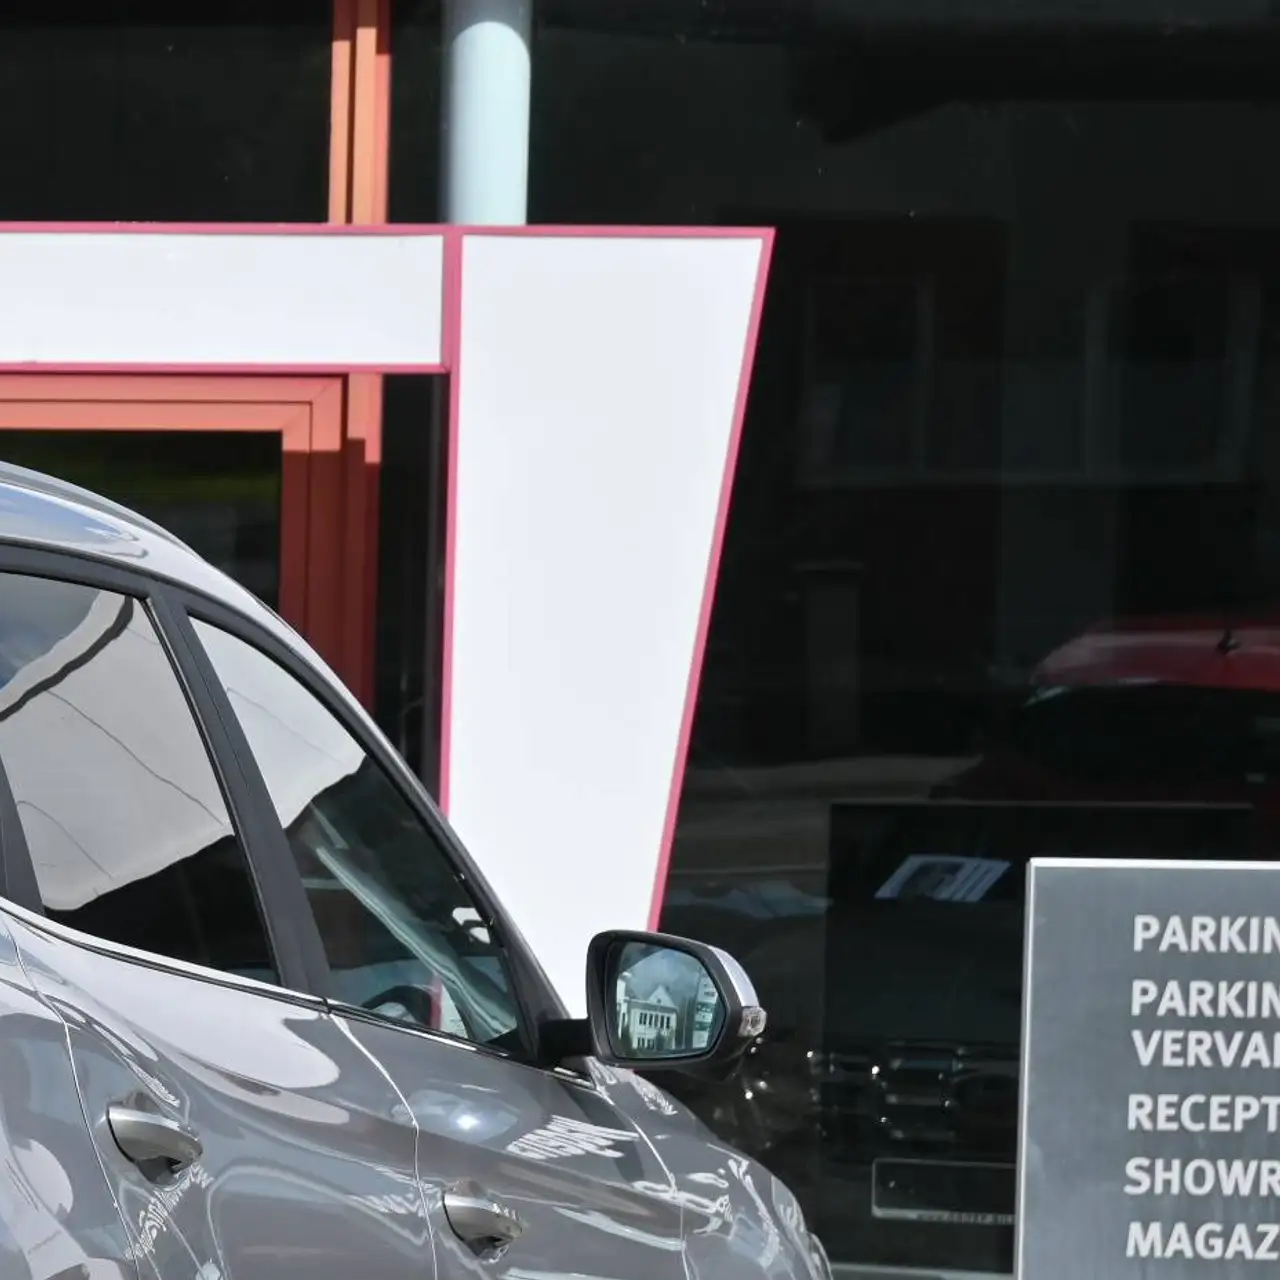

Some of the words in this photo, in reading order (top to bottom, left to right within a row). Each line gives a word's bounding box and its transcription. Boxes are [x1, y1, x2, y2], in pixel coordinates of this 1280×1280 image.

[1130, 1029, 1280, 1069] VERVA
[1127, 1093, 1280, 1133] RECEPT
[1123, 1156, 1280, 1197] SHOWR
[1125, 1220, 1280, 1261] MAGAZ
